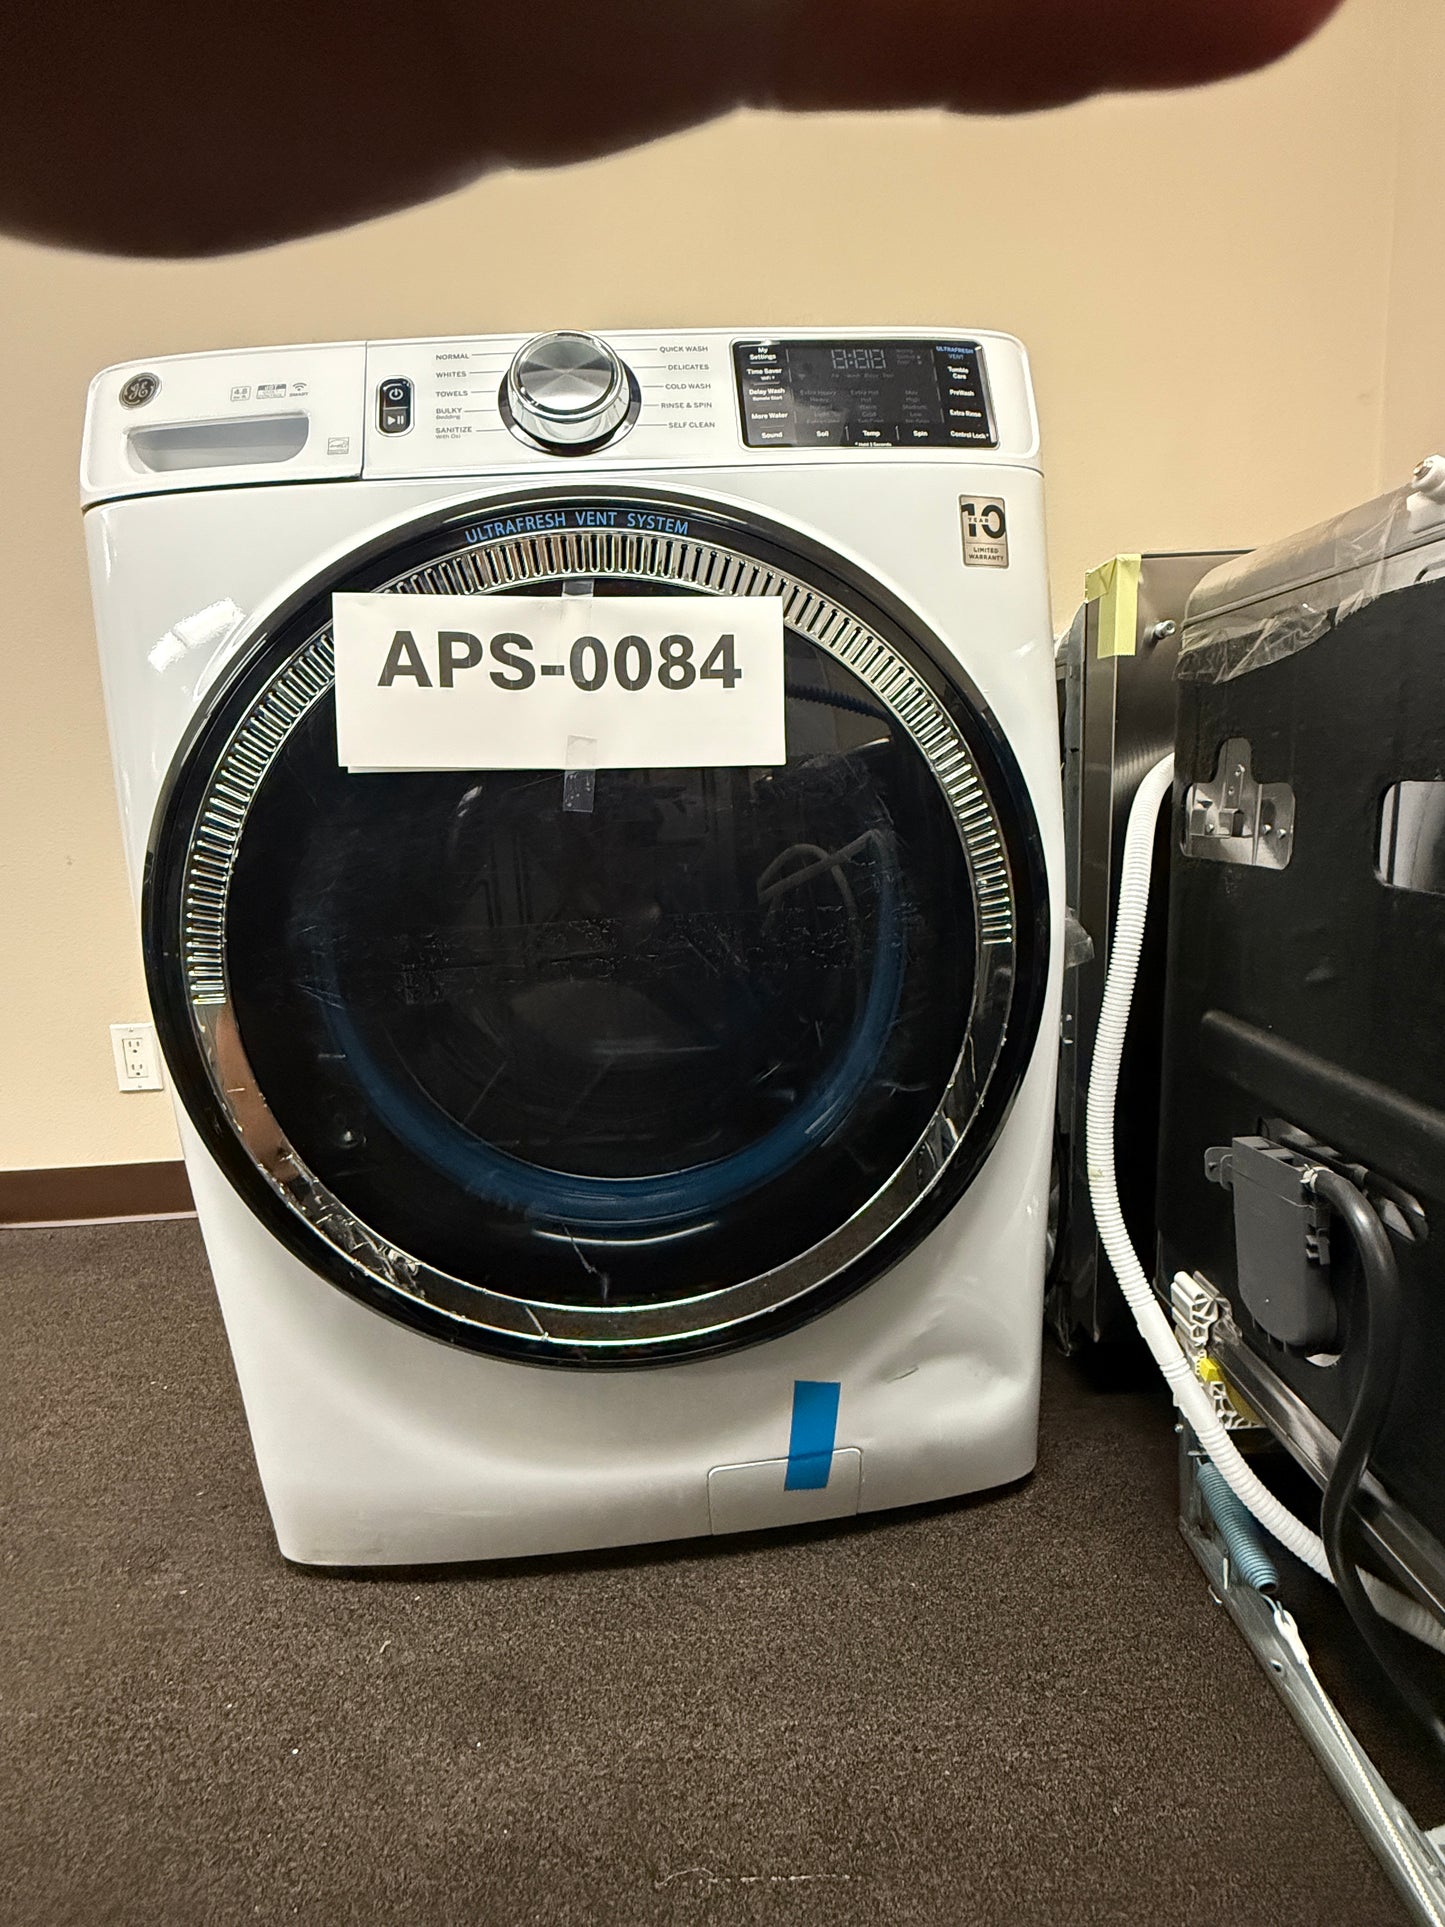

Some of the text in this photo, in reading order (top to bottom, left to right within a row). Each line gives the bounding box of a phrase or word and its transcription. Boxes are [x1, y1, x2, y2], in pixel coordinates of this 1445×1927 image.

[936, 345, 974, 354] ULTRAFRESH
[749, 353, 777, 361] Settings
[947, 366, 969, 374] Tumble
[435, 426, 472, 434] SANITIZE
[862, 429, 881, 438] Temp
[912, 430, 929, 438] Spin
[950, 430, 971, 438] Control
[961, 503, 1006, 539] 10
[464, 511, 689, 544] ULTRAFRESH VENT SYSTEM
[378, 630, 742, 691] APS-0084
